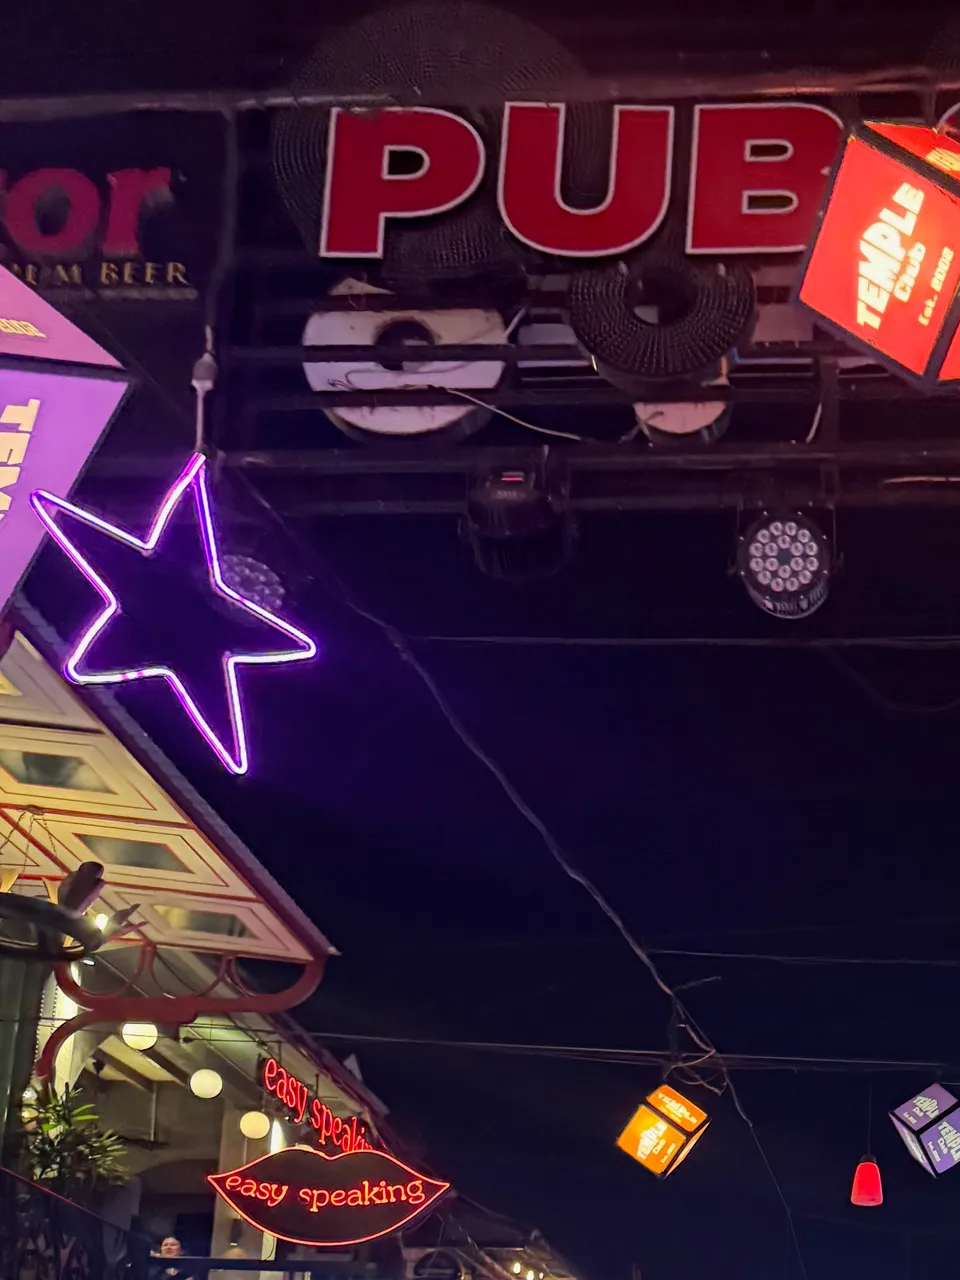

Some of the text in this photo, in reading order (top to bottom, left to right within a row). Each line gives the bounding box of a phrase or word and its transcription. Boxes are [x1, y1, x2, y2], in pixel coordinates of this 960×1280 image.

[0, 167, 172, 257] or
[319, 101, 844, 258] PUB
[100, 261, 190, 286] BEER
[856, 181, 925, 332] TEMPLE
[893, 241, 926, 304] Club
[264, 1057, 374, 1152] easy speaki
[225, 1175, 427, 1213] easy speaking
